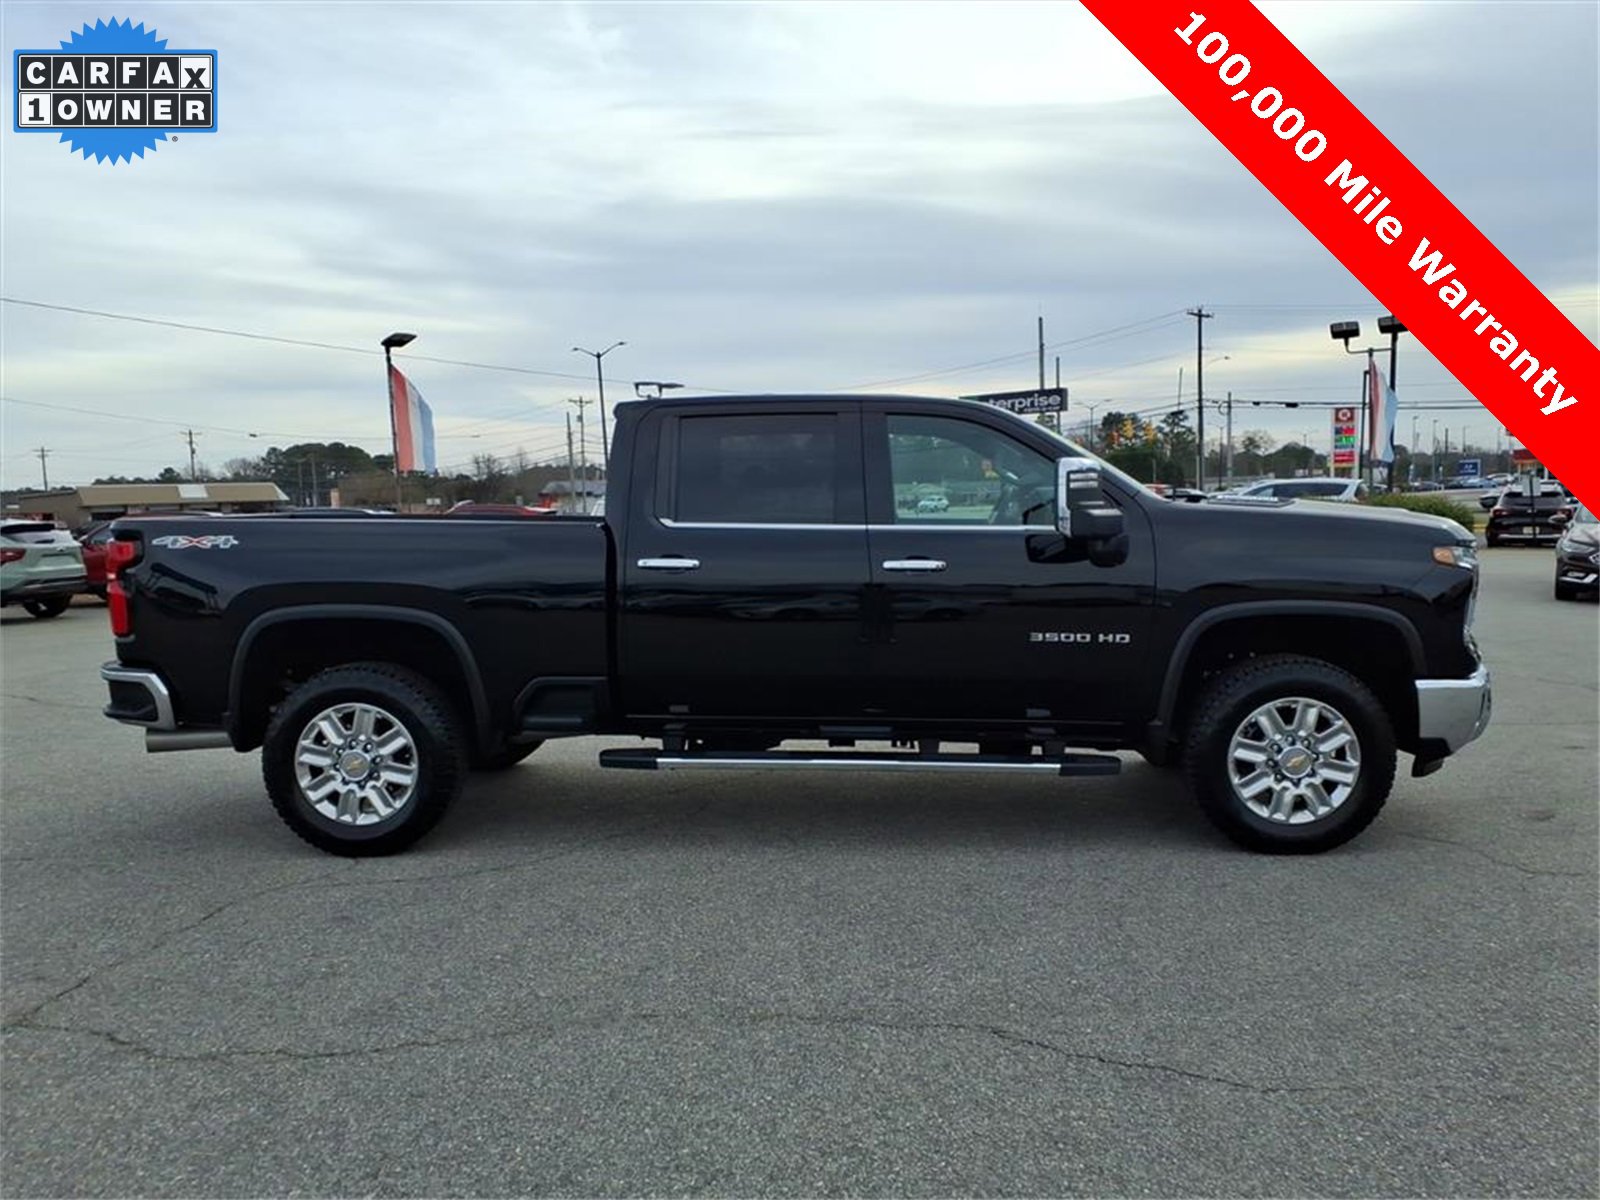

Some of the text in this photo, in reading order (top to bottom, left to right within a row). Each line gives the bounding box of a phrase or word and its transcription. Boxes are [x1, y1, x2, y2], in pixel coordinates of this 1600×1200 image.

[988, 394, 1061, 411] terprise
[1029, 632, 1130, 643] 3500 HD
